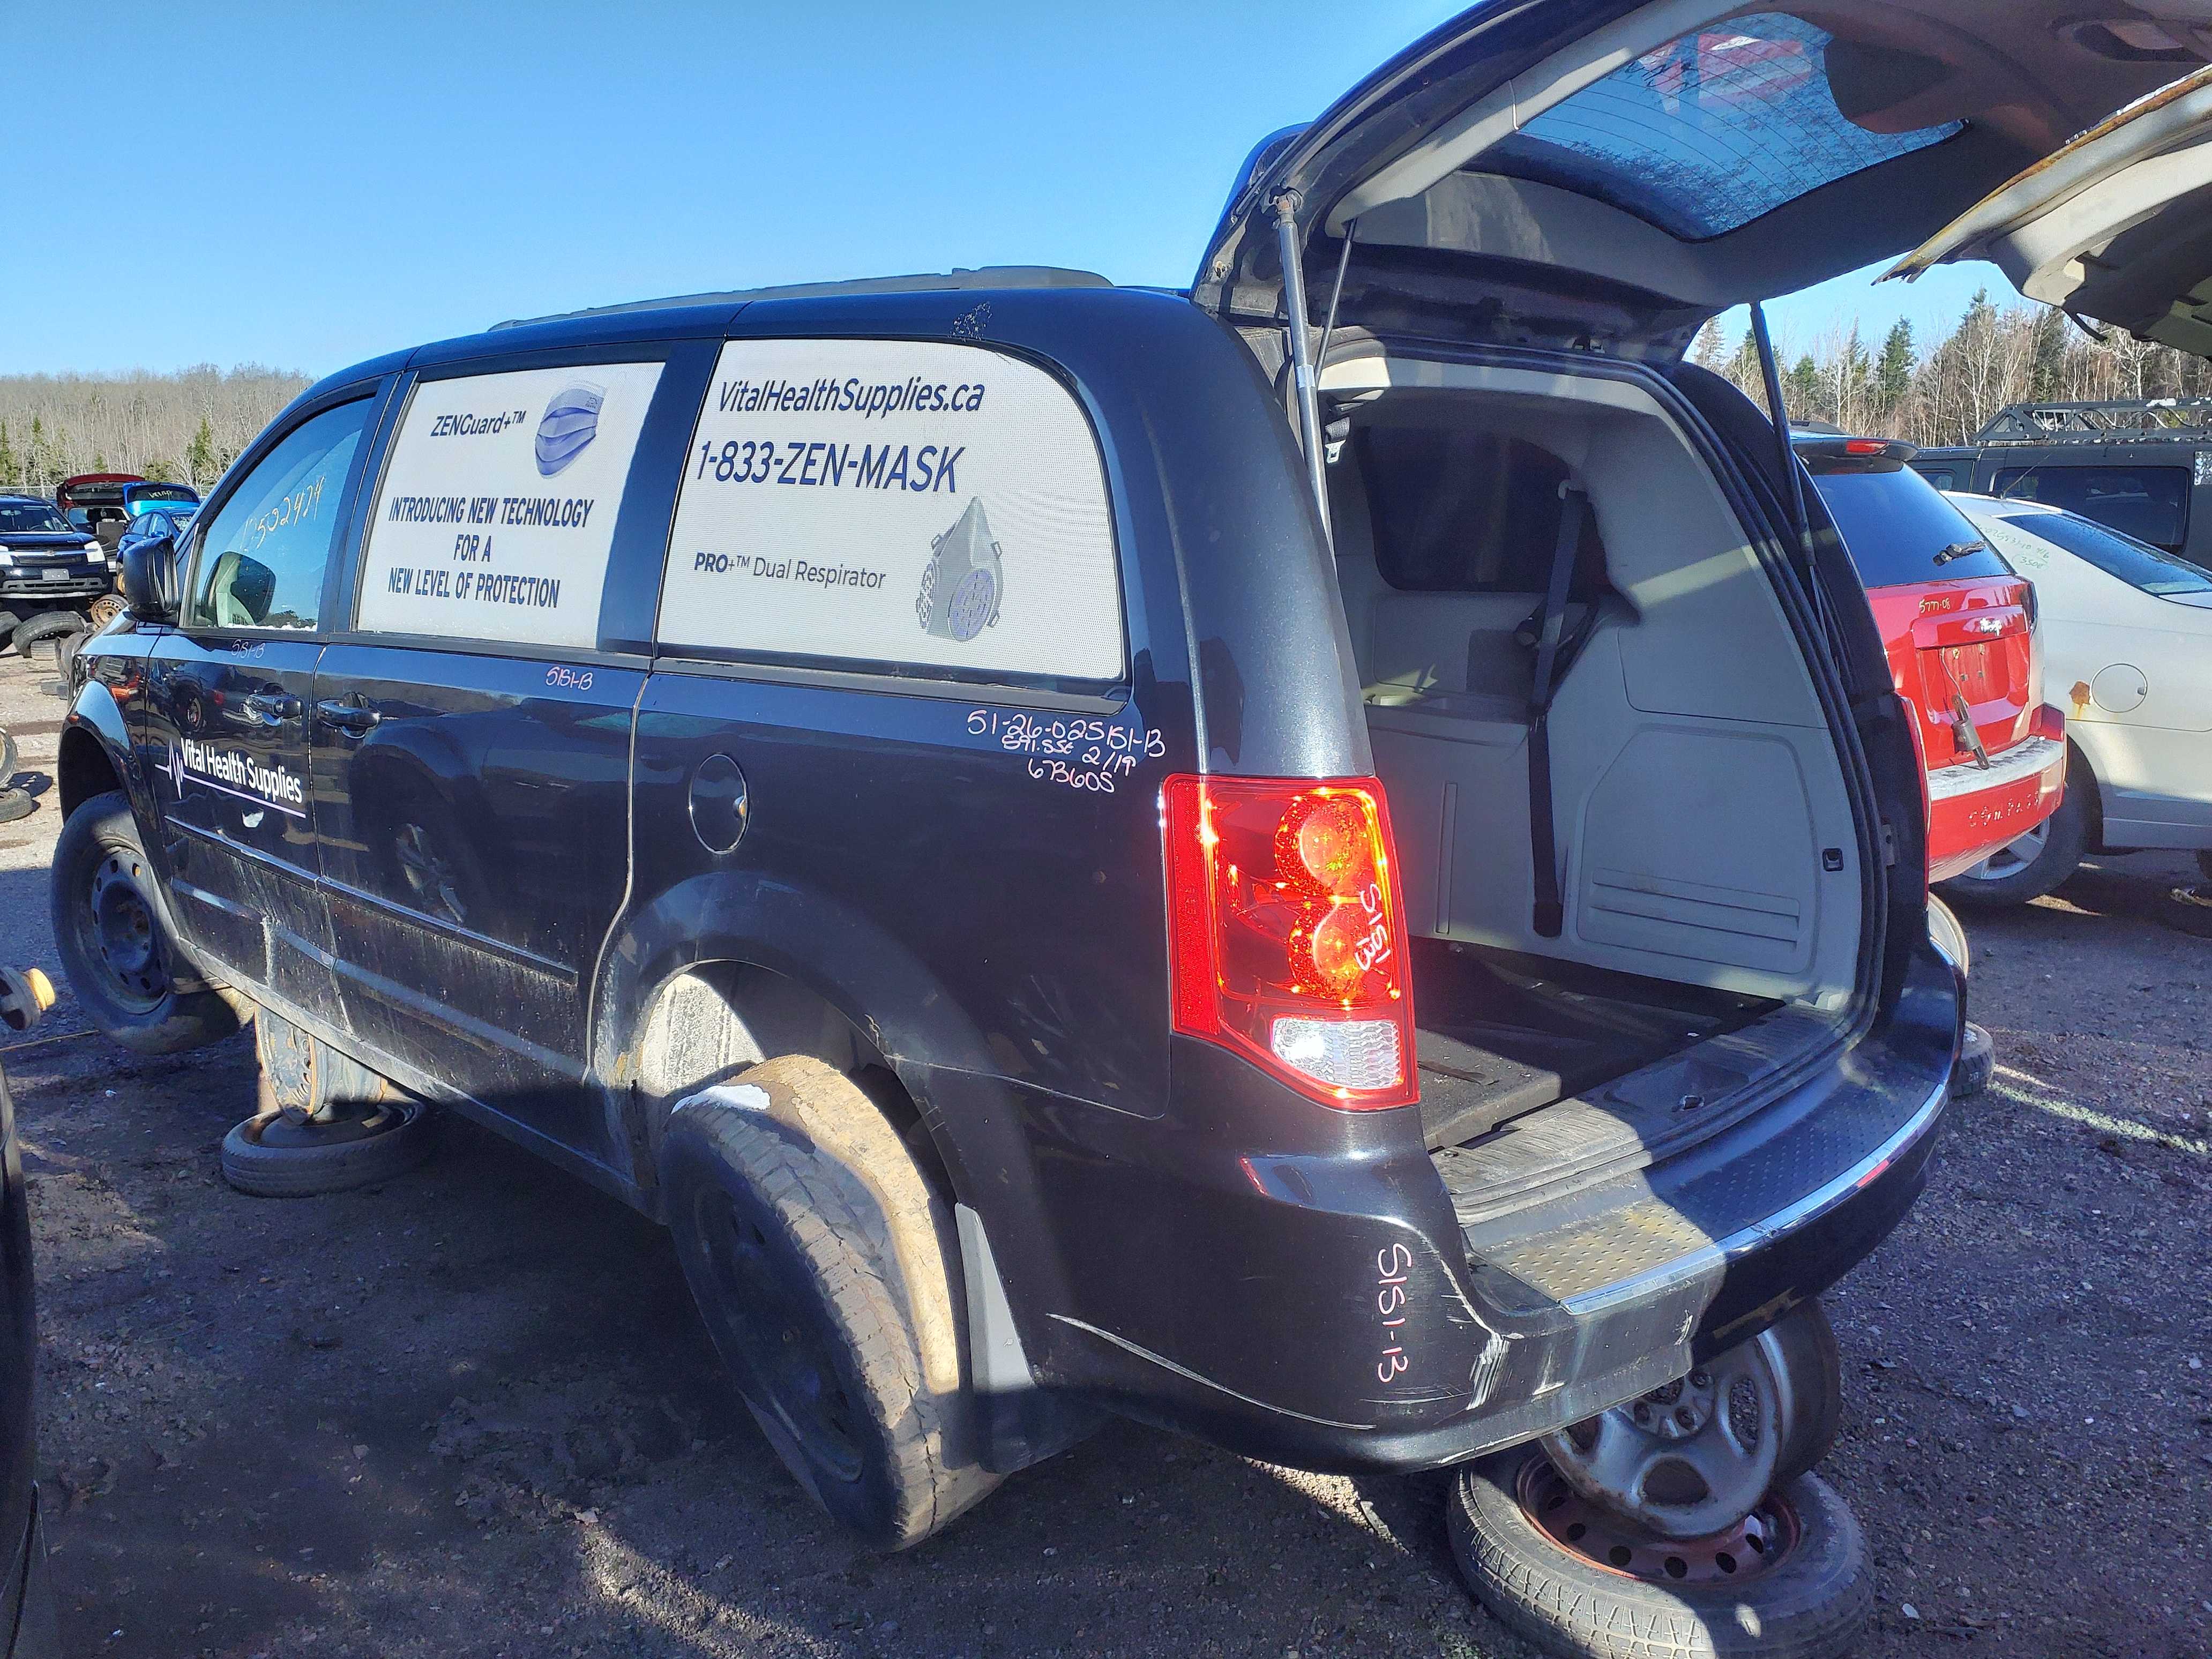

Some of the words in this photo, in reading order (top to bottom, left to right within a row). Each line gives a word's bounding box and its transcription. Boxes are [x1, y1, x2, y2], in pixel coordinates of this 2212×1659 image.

[719, 376, 985, 420] VitalHealthSupplies.ca
[697, 440, 965, 494] 1-833-ZEN-MASK
[388, 497, 466, 524] INTRODUCING
[468, 497, 498, 524] NEW
[500, 497, 594, 528] TECHNOLOGY
[454, 534, 479, 562] FOR
[481, 535, 491, 562] A
[388, 567, 412, 593] NEW
[415, 569, 450, 597] LEVEL
[455, 572, 473, 600] OF
[475, 574, 561, 608] PROTECTION
[753, 557, 789, 580] Dual
[795, 561, 886, 590] Respirator
[181, 737, 205, 773] Vital
[206, 745, 246, 786] Health
[246, 756, 302, 804] Supplies
